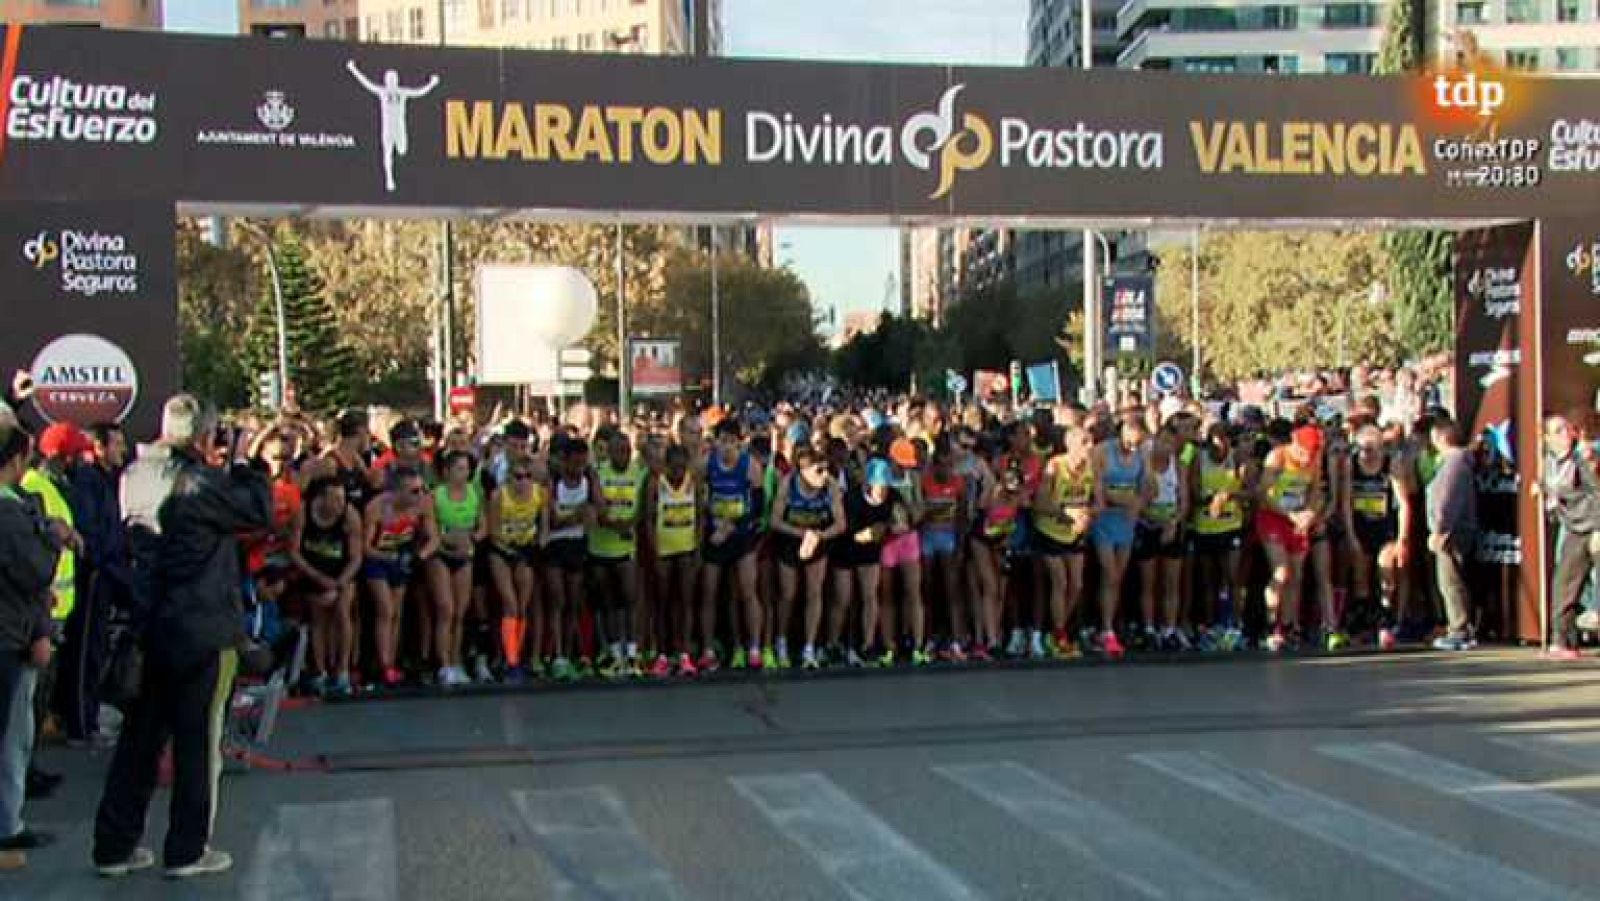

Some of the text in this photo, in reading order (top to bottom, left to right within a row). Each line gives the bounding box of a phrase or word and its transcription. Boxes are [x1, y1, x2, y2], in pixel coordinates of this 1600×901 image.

[10, 75, 156, 111] Cultura del
[7, 107, 157, 143] Esfuerzo
[197, 129, 276, 144] AJUNTAMENT
[278, 131, 296, 146] DE
[446, 100, 1427, 176] MARATON Divina Pastora VALENCIA
[61, 230, 124, 251] Divina
[61, 250, 136, 270] Pastora
[61, 271, 138, 296] Seguros
[42, 365, 121, 384] AMSTEL
